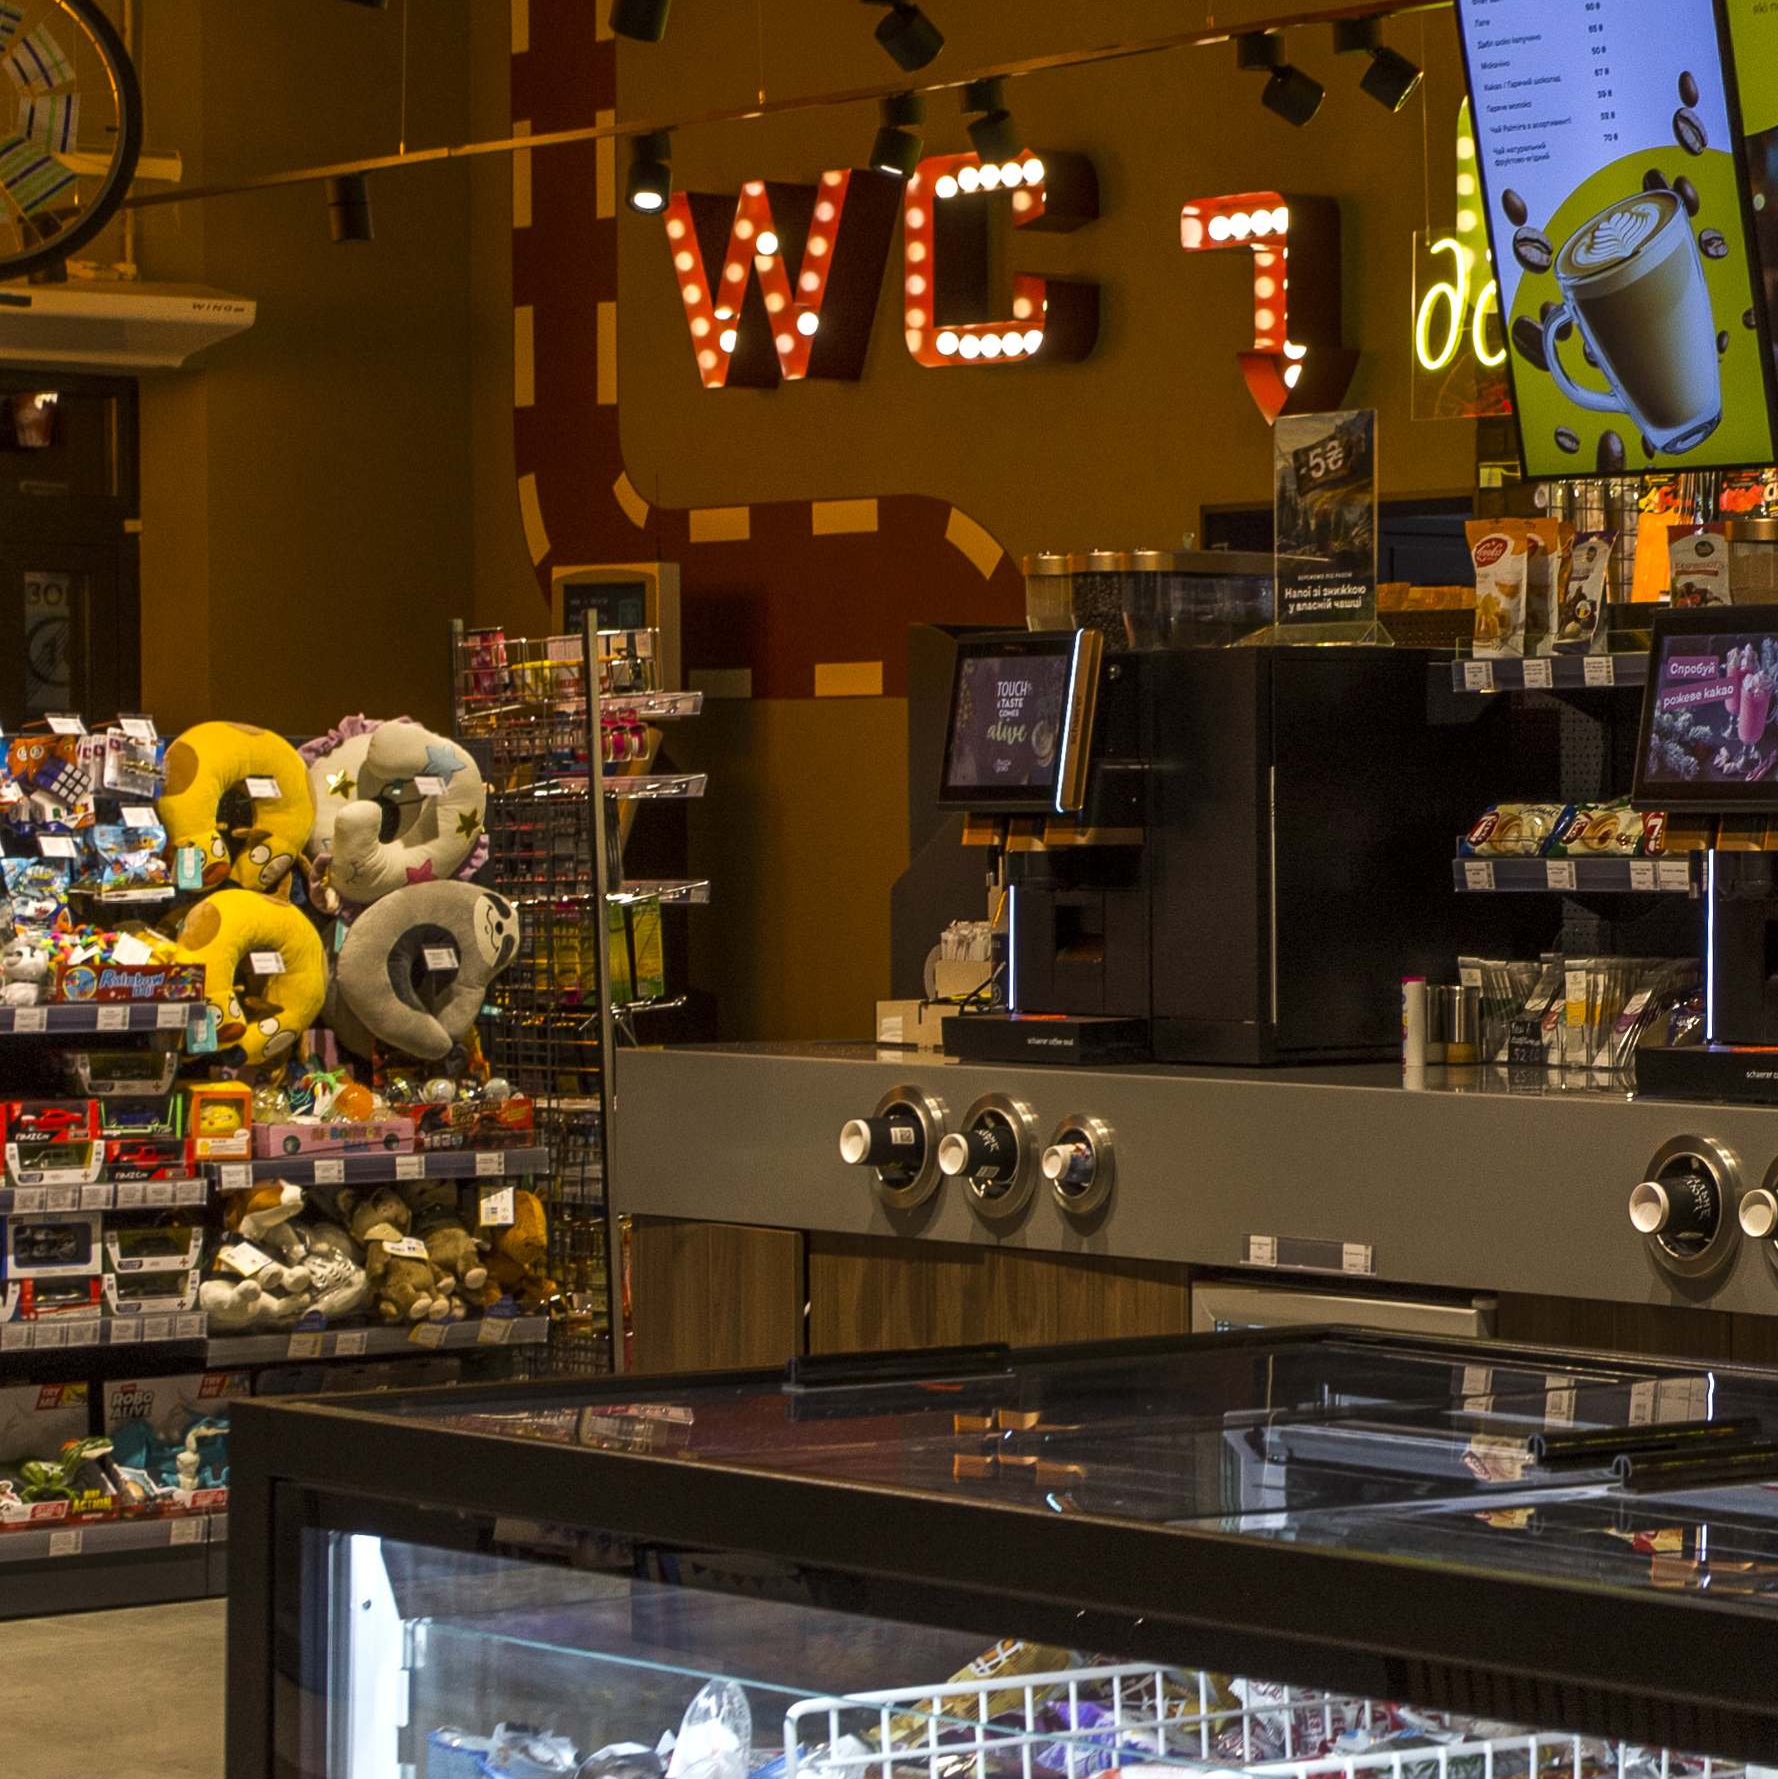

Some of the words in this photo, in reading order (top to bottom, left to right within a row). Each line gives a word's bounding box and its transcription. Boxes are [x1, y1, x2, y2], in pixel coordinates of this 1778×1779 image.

[1752, 1, 1769, 15] які
[664, 148, 1048, 389] WC
[1284, 585, 1312, 599] Напої
[1313, 585, 1321, 597] зі
[1322, 584, 1366, 597] знижкою
[1288, 603, 1295, 614] у
[1296, 598, 1332, 612] власній
[1333, 596, 1362, 609] чашці
[1669, 662, 1716, 677] Спробуй
[997, 680, 1028, 697] TOUCH
[1663, 690, 1702, 710] рожеве
[1703, 684, 1735, 700] какао
[985, 717, 1029, 746] alive
[100, 969, 165, 989] Rainbow
[1746, 1070, 1772, 1080] schaerer
[111, 1391, 155, 1407] ROBO
[109, 1405, 153, 1420] ALIVE
[72, 1496, 114, 1515] ACTION
